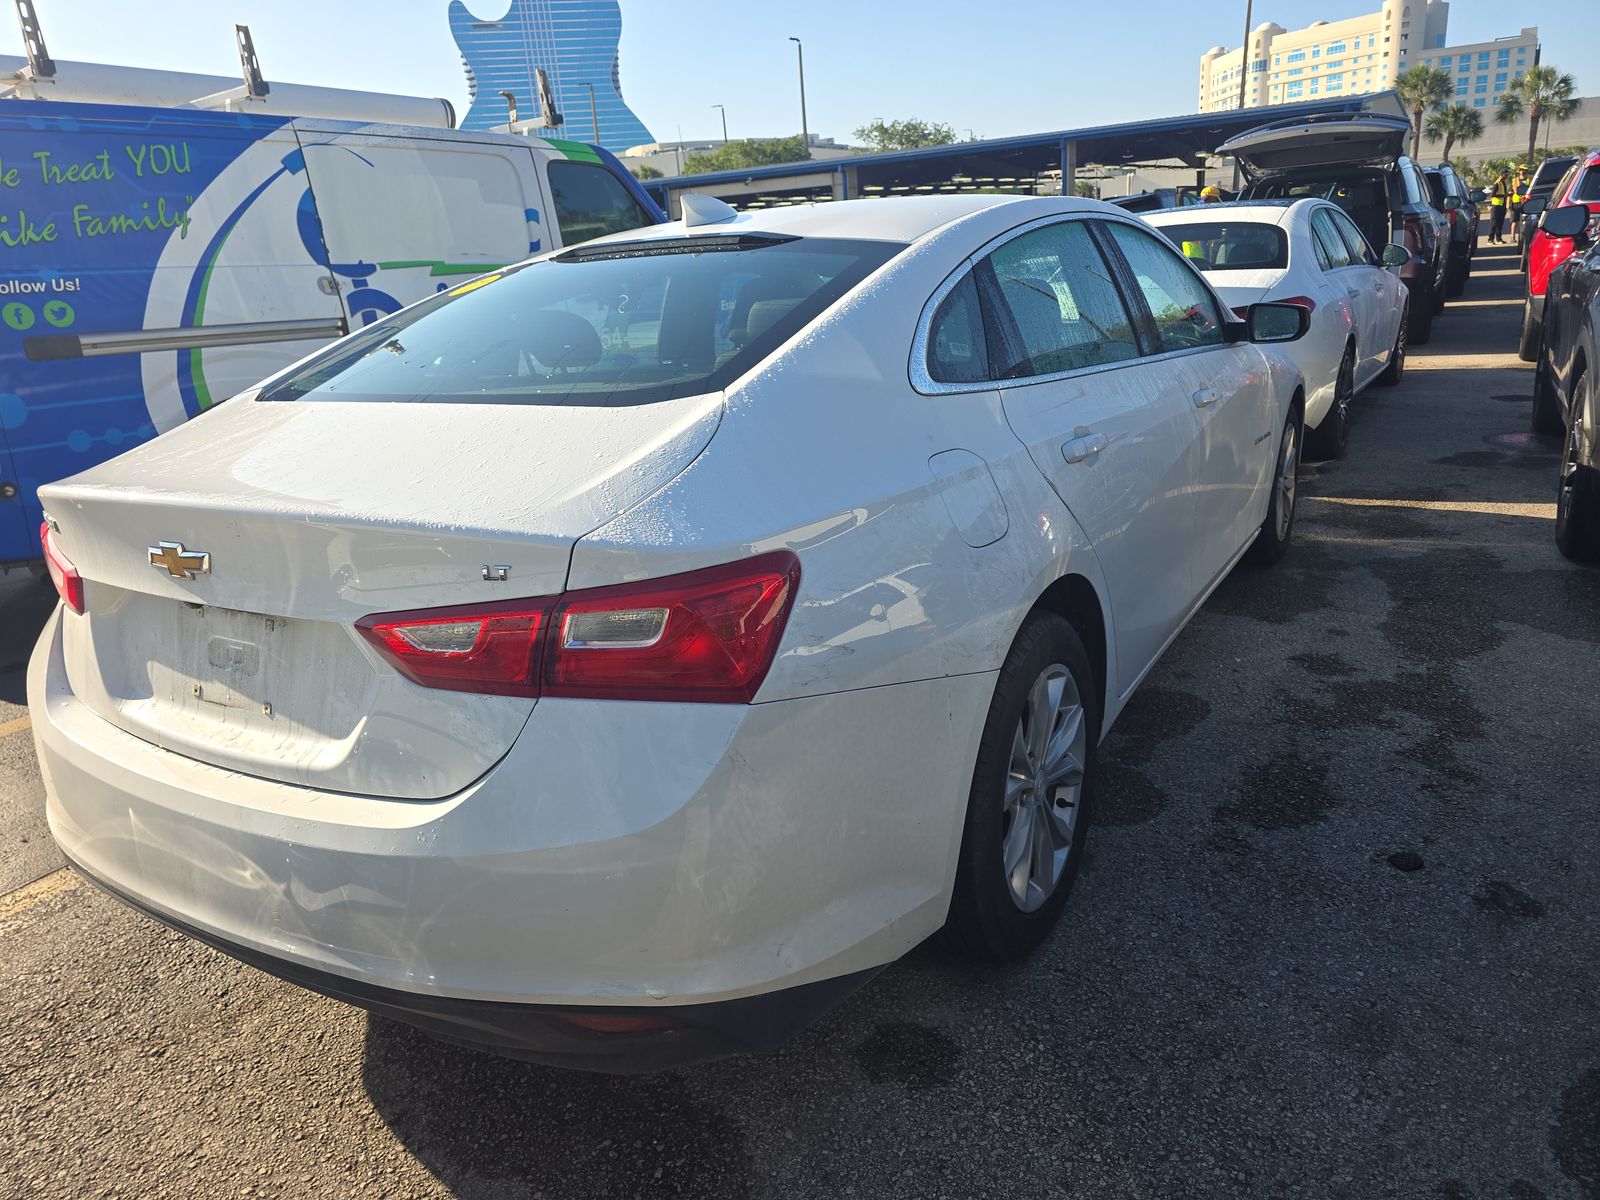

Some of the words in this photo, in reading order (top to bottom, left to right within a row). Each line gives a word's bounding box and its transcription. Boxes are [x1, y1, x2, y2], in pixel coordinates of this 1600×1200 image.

[0, 154, 21, 187] e
[32, 149, 115, 185] Treat
[125, 142, 191, 177] YOU
[0, 210, 58, 247] ike
[72, 195, 193, 240] Family"
[0, 281, 46, 294] ollow
[51, 278, 81, 292] Us!
[481, 564, 512, 581] LT
